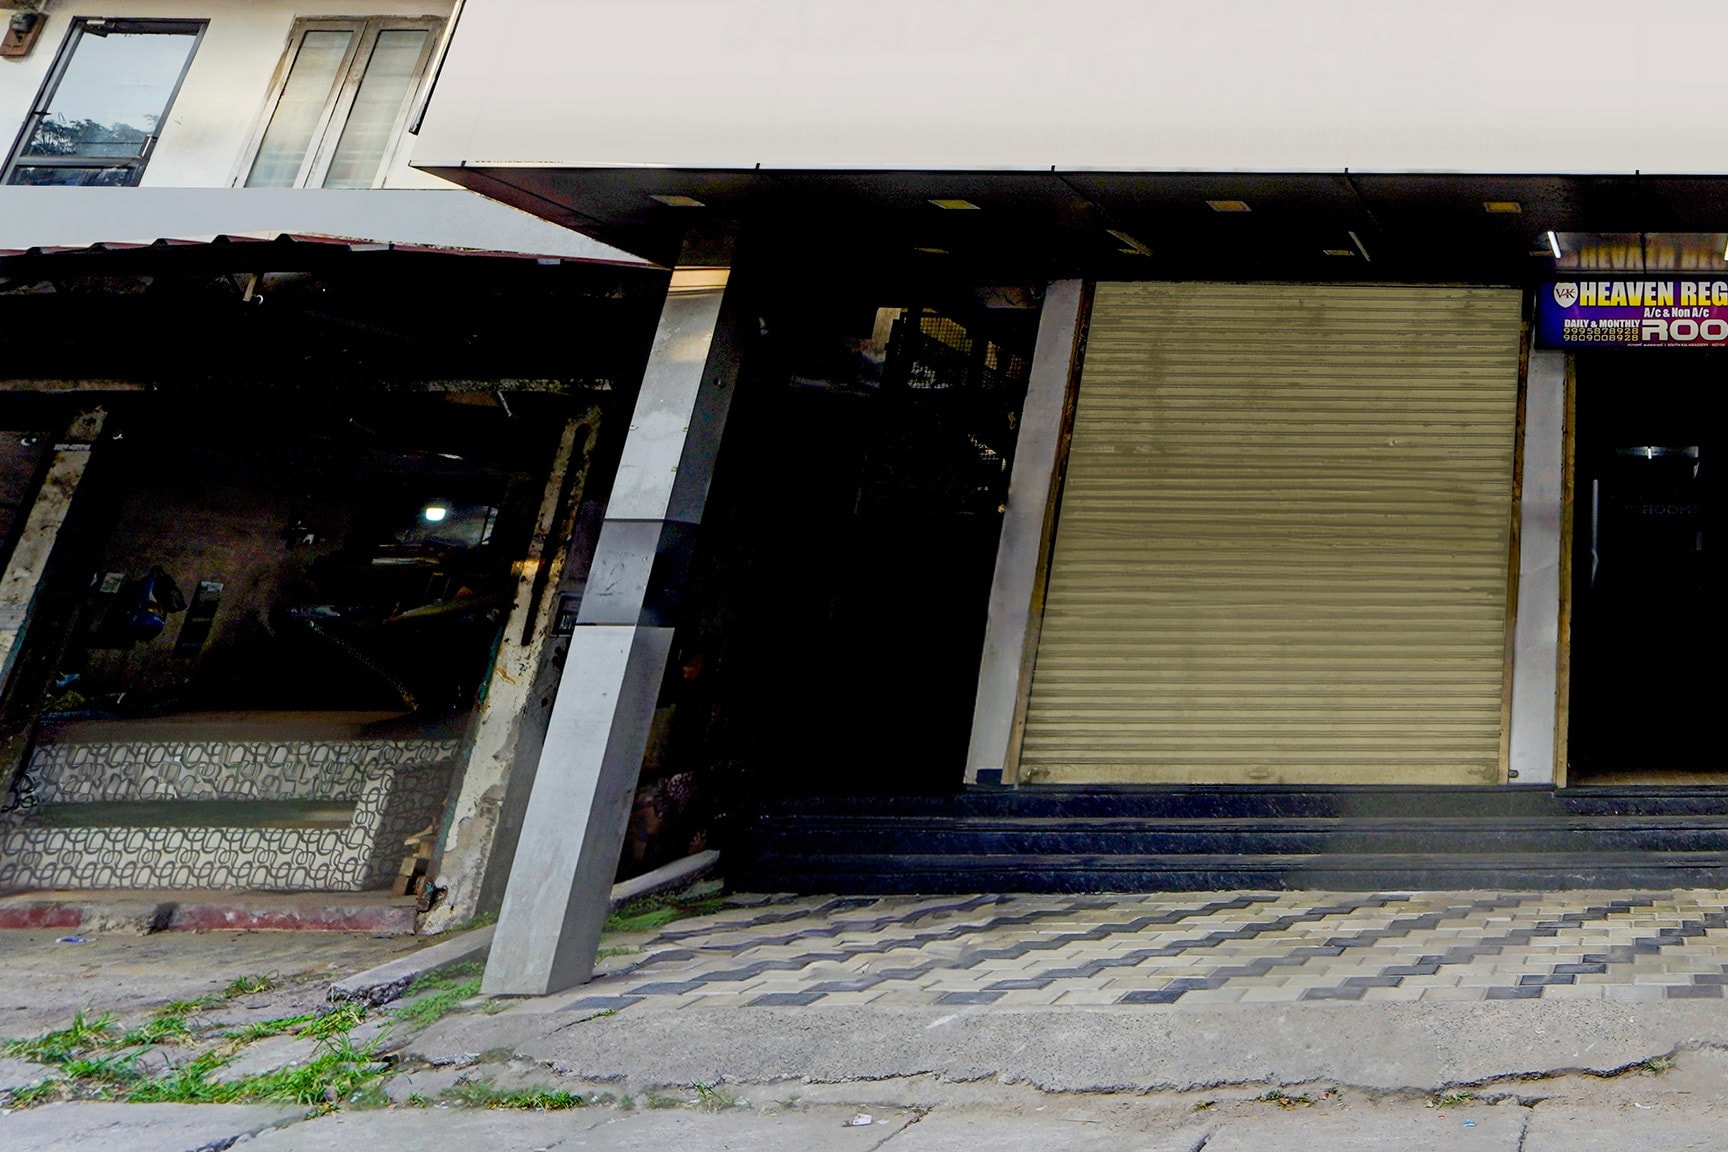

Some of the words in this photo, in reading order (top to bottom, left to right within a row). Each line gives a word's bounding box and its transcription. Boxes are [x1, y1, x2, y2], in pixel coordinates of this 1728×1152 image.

[1579, 281, 1674, 306] HEAVEN
[1643, 307, 1662, 318] A/c
[1663, 308, 1670, 318] &
[1671, 307, 1691, 318] Non
[1692, 308, 1710, 318] A/c
[1564, 319, 1589, 328] DAILY
[1590, 320, 1598, 328] &
[1599, 319, 1640, 328] MONTHLY
